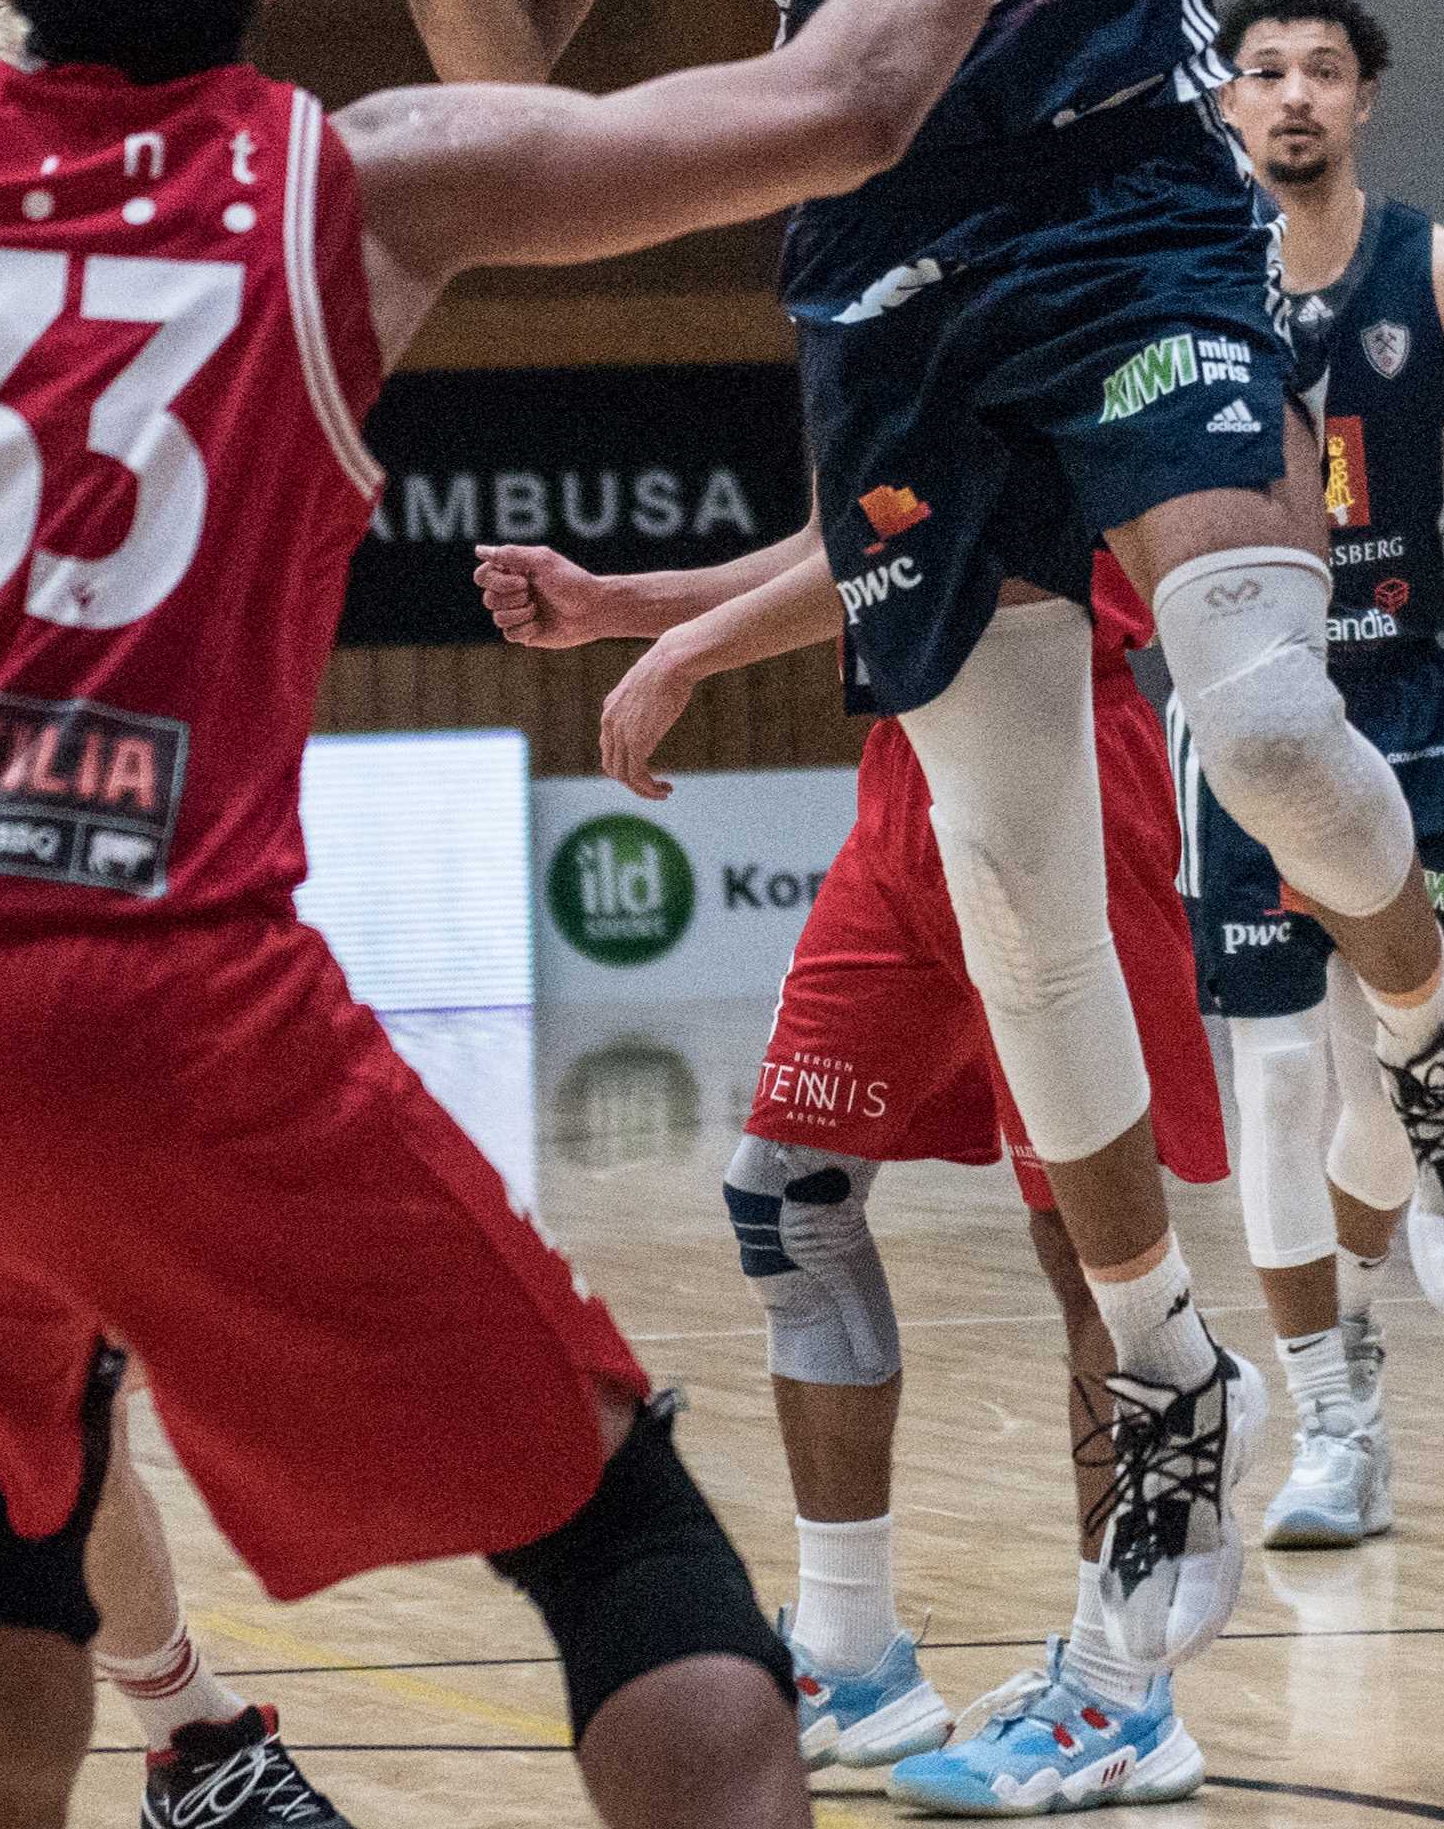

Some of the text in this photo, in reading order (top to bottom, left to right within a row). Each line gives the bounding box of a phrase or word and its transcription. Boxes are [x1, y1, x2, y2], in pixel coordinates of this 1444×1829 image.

[1197, 336, 1252, 364] mini
[1202, 360, 1251, 385] pris
[1207, 421, 1262, 432] adidas
[1328, 536, 1404, 567] SBERG
[836, 556, 923, 625] pwc
[1222, 921, 1292, 954] pwc
[793, 1051, 854, 1073] BERGEN
[760, 1061, 888, 1117] TENNIS
[785, 1110, 837, 1127] ARENA
